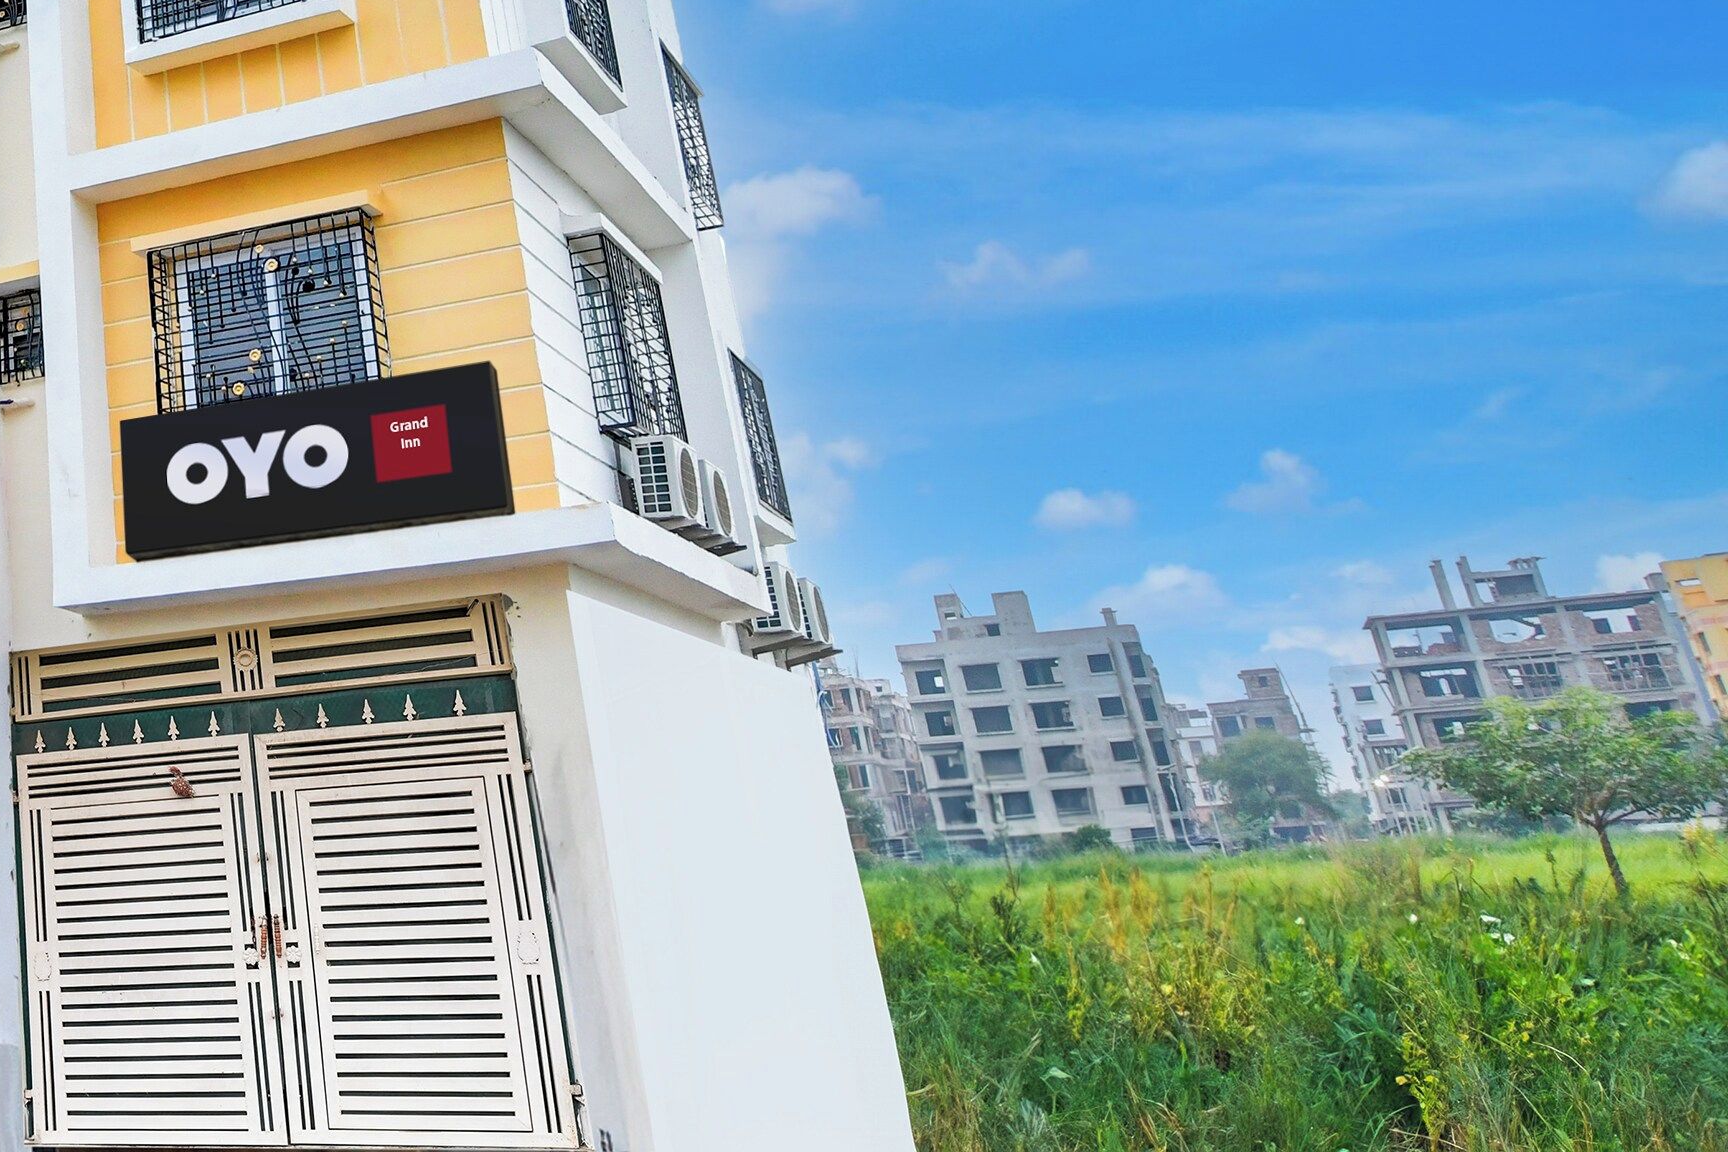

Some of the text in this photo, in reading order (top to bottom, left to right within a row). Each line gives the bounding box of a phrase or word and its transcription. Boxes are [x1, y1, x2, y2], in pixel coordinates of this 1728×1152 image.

[389, 415, 429, 433] Grand
[400, 437, 421, 450] Inn
[166, 424, 349, 505] OYO
